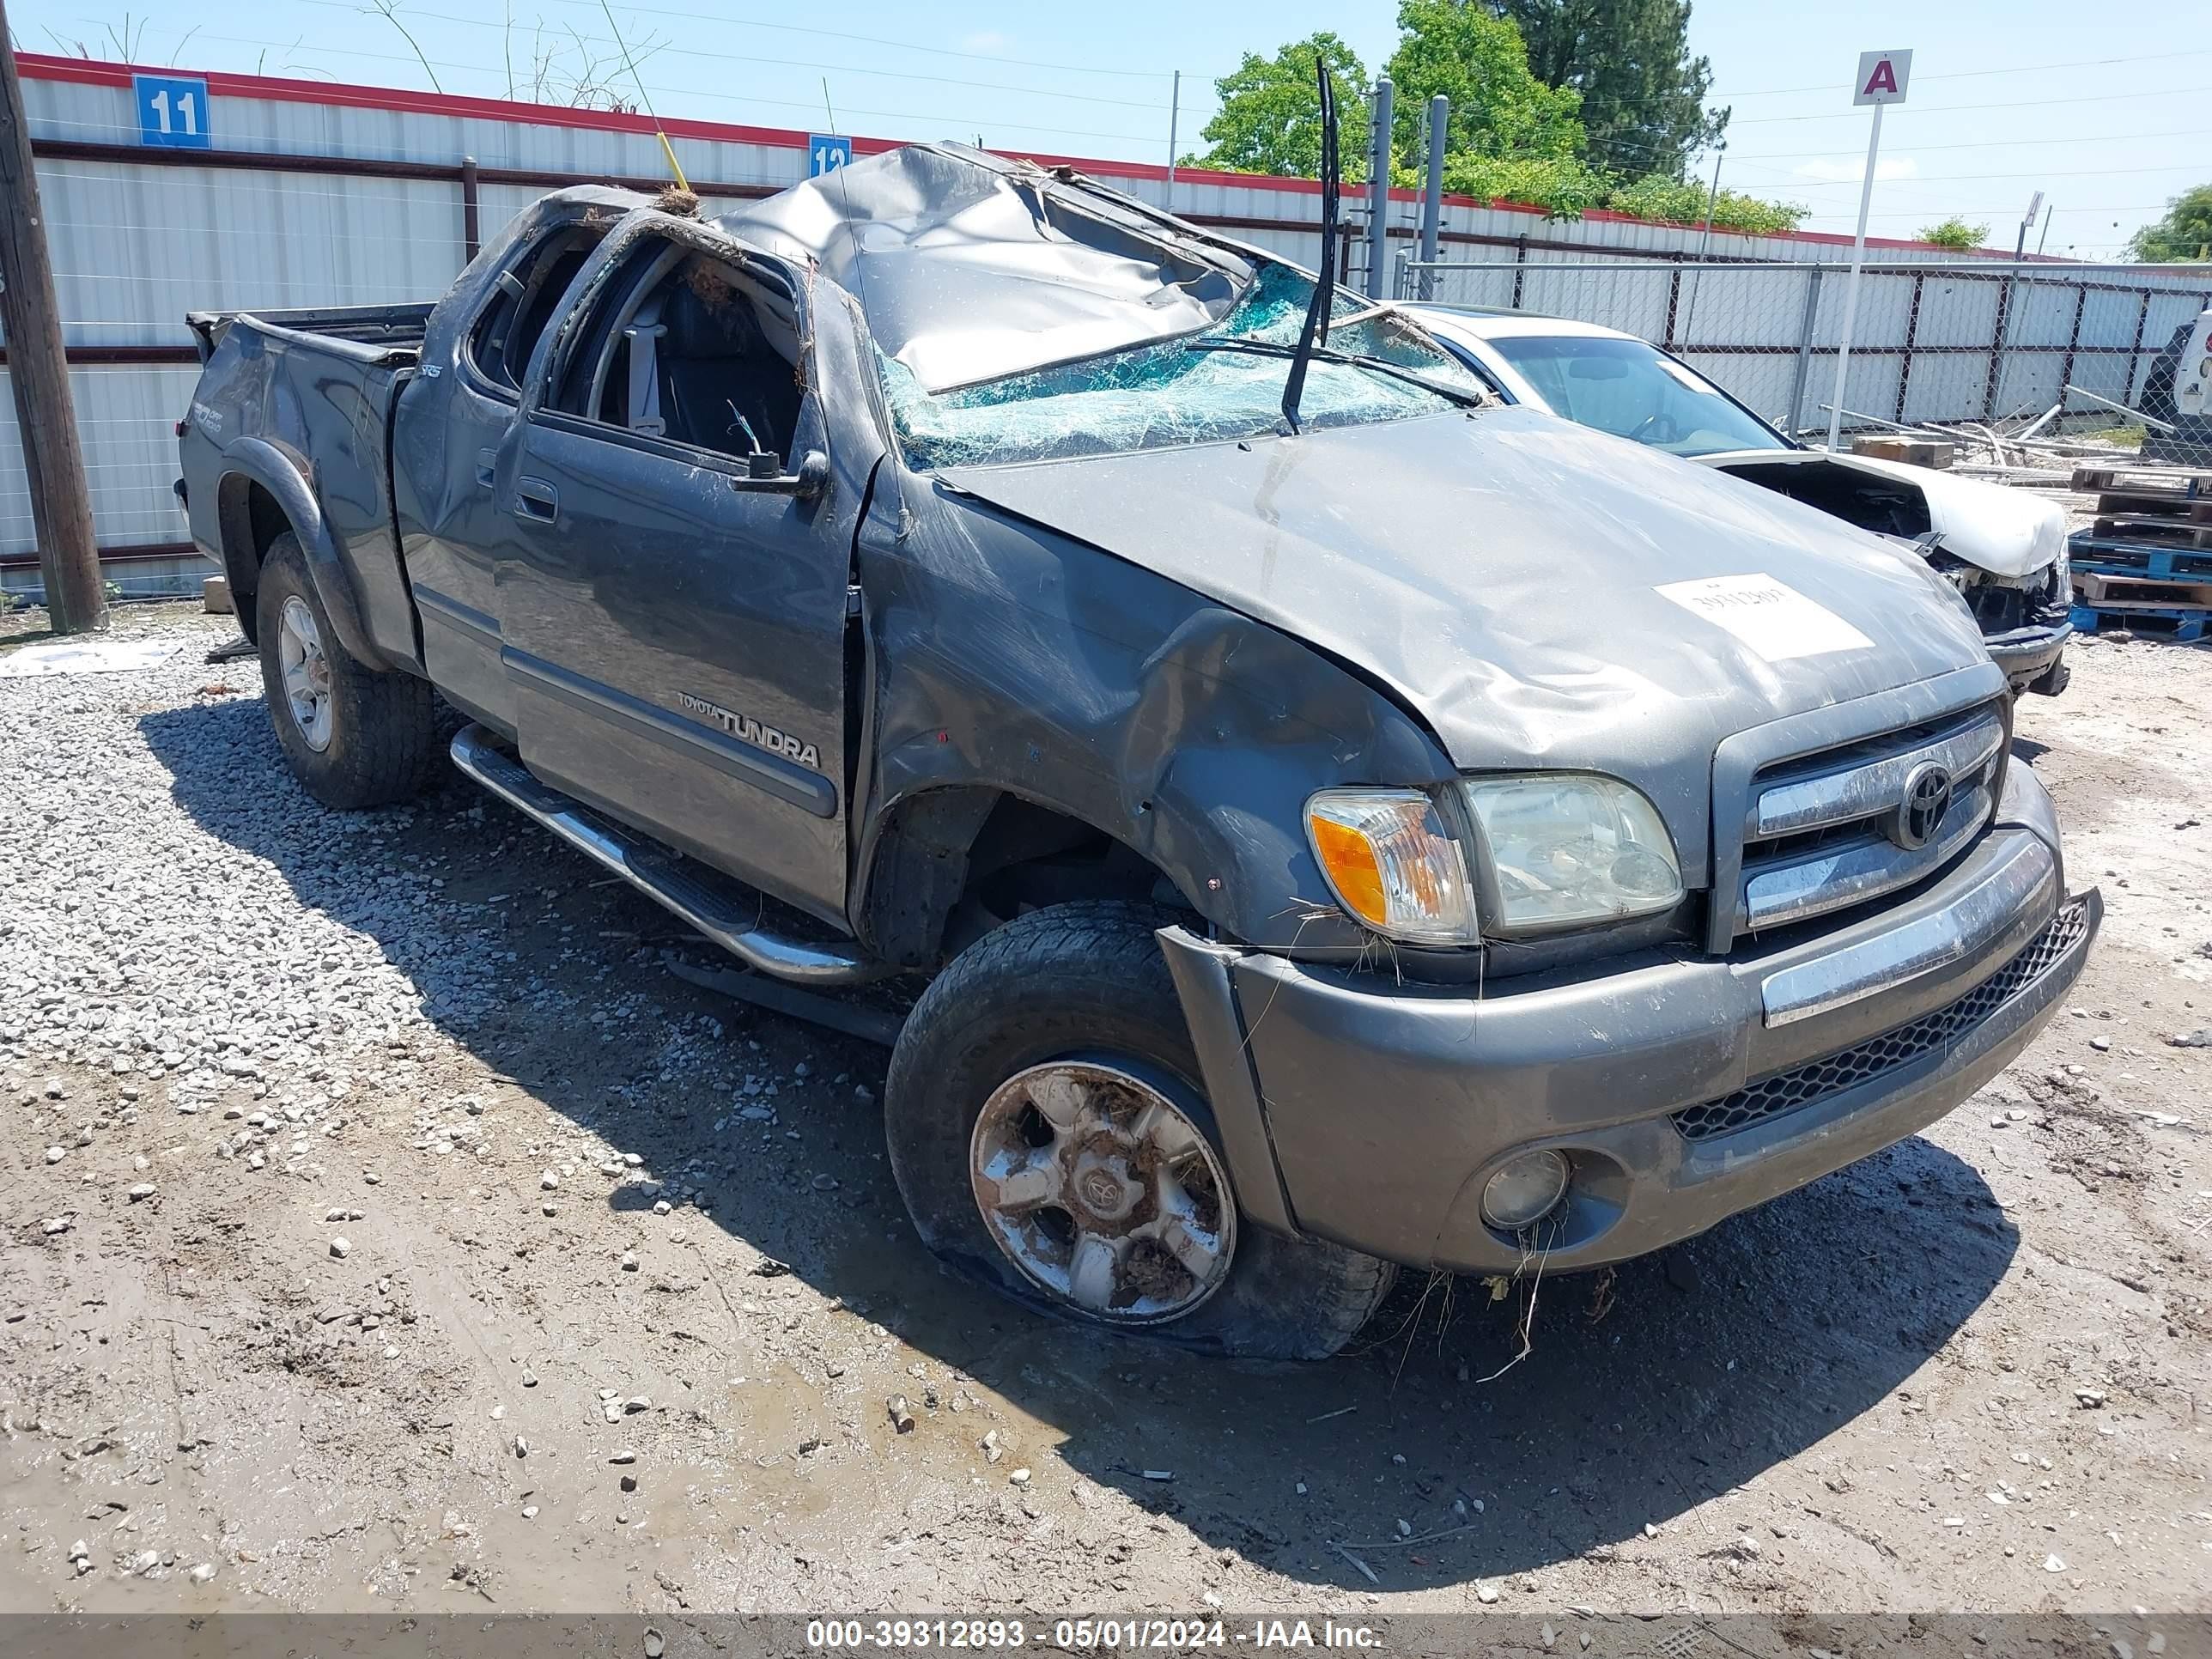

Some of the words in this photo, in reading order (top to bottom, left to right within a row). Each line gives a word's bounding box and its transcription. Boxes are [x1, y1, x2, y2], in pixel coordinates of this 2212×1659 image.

[1863, 60, 1898, 94] A
[151, 90, 197, 136] 11
[678, 691, 721, 720] TOYOTA
[717, 707, 822, 769] TUNDRA
